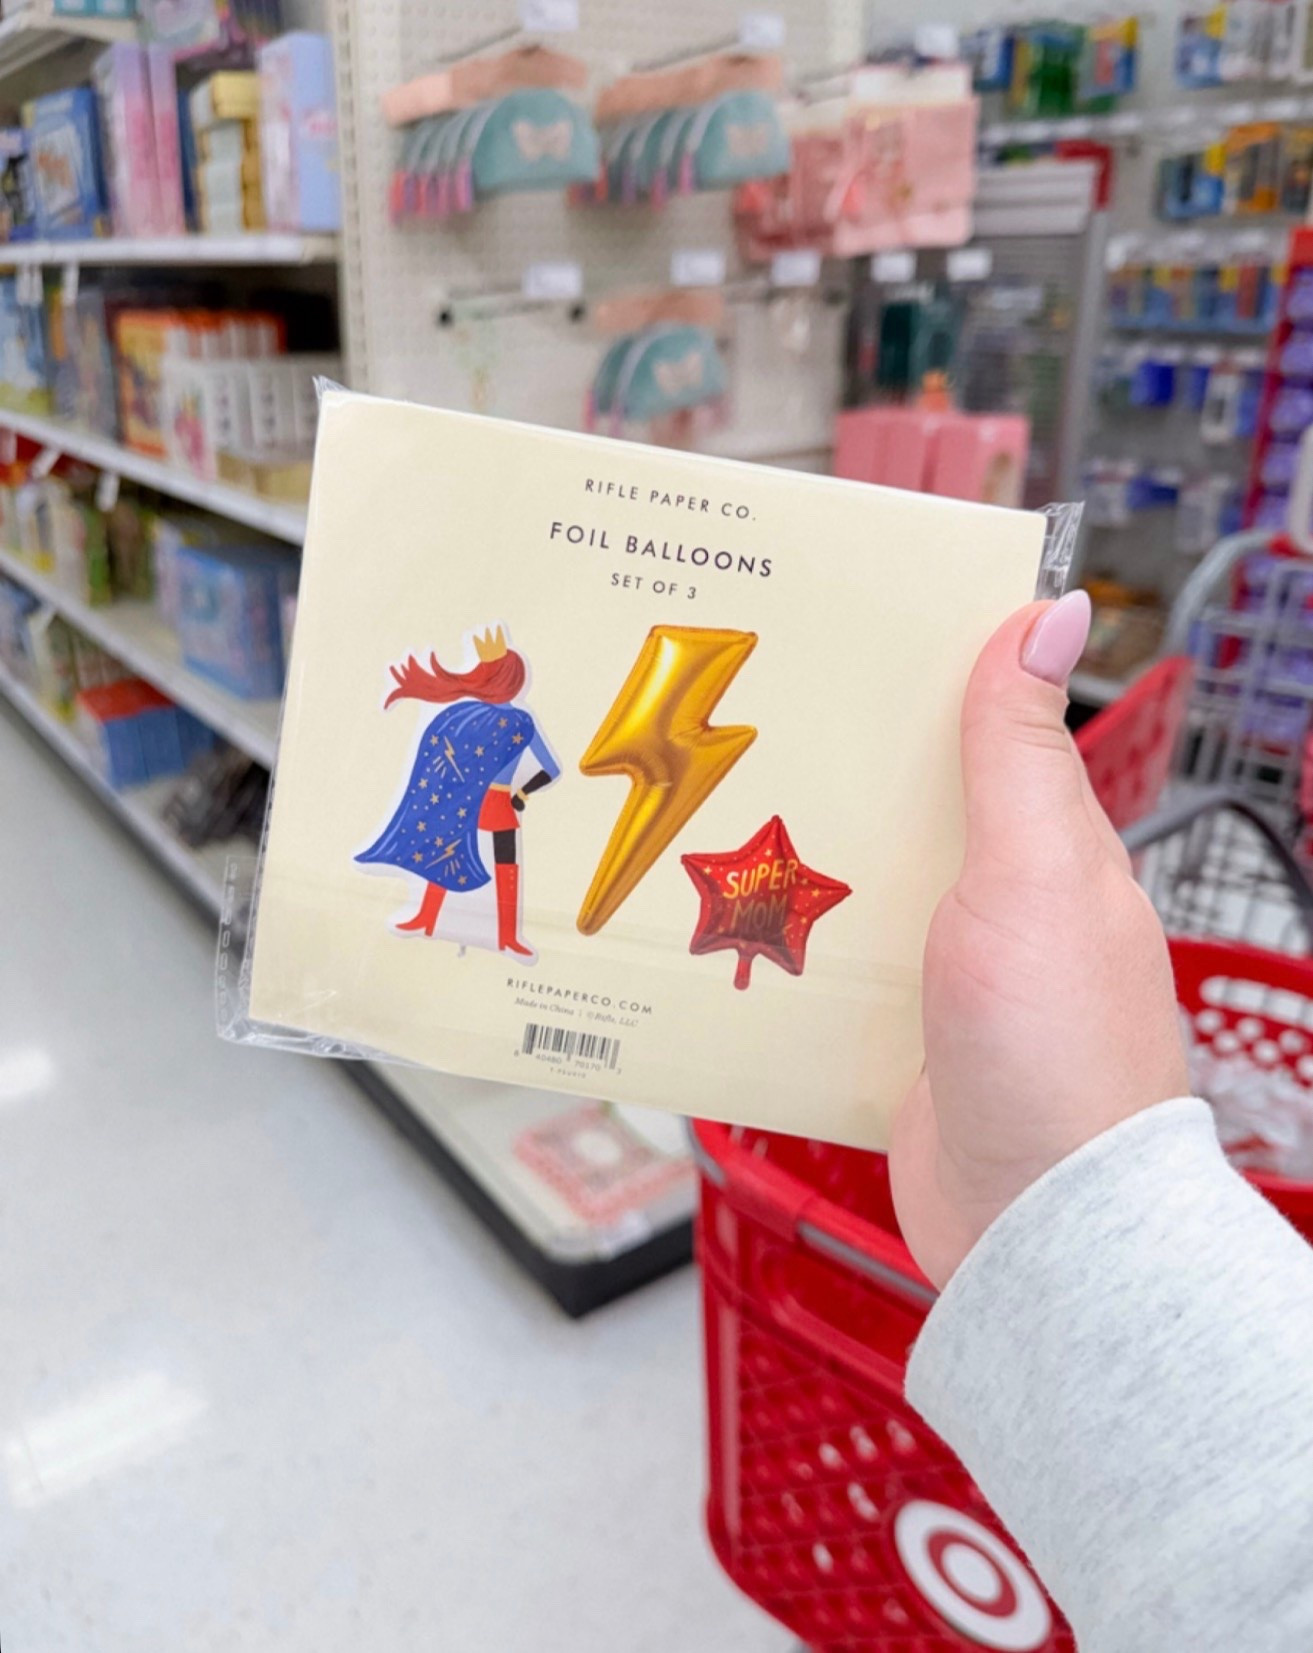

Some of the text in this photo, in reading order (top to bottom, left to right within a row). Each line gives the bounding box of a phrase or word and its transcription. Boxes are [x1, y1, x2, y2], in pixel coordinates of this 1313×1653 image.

[585, 479, 756, 521] RIFLE PAPER CO.
[550, 522, 772, 577] FOIL BALLOONS
[611, 573, 697, 600] SET OF 3
[722, 859, 798, 899] SUPER
[730, 895, 787, 933] MOM
[507, 978, 652, 1014] RIFLEPAPERCO.COM
[514, 997, 538, 1008] Made
[540, 1002, 548, 1011] in
[549, 1004, 575, 1016] China
[619, 1017, 639, 1028] LLC
